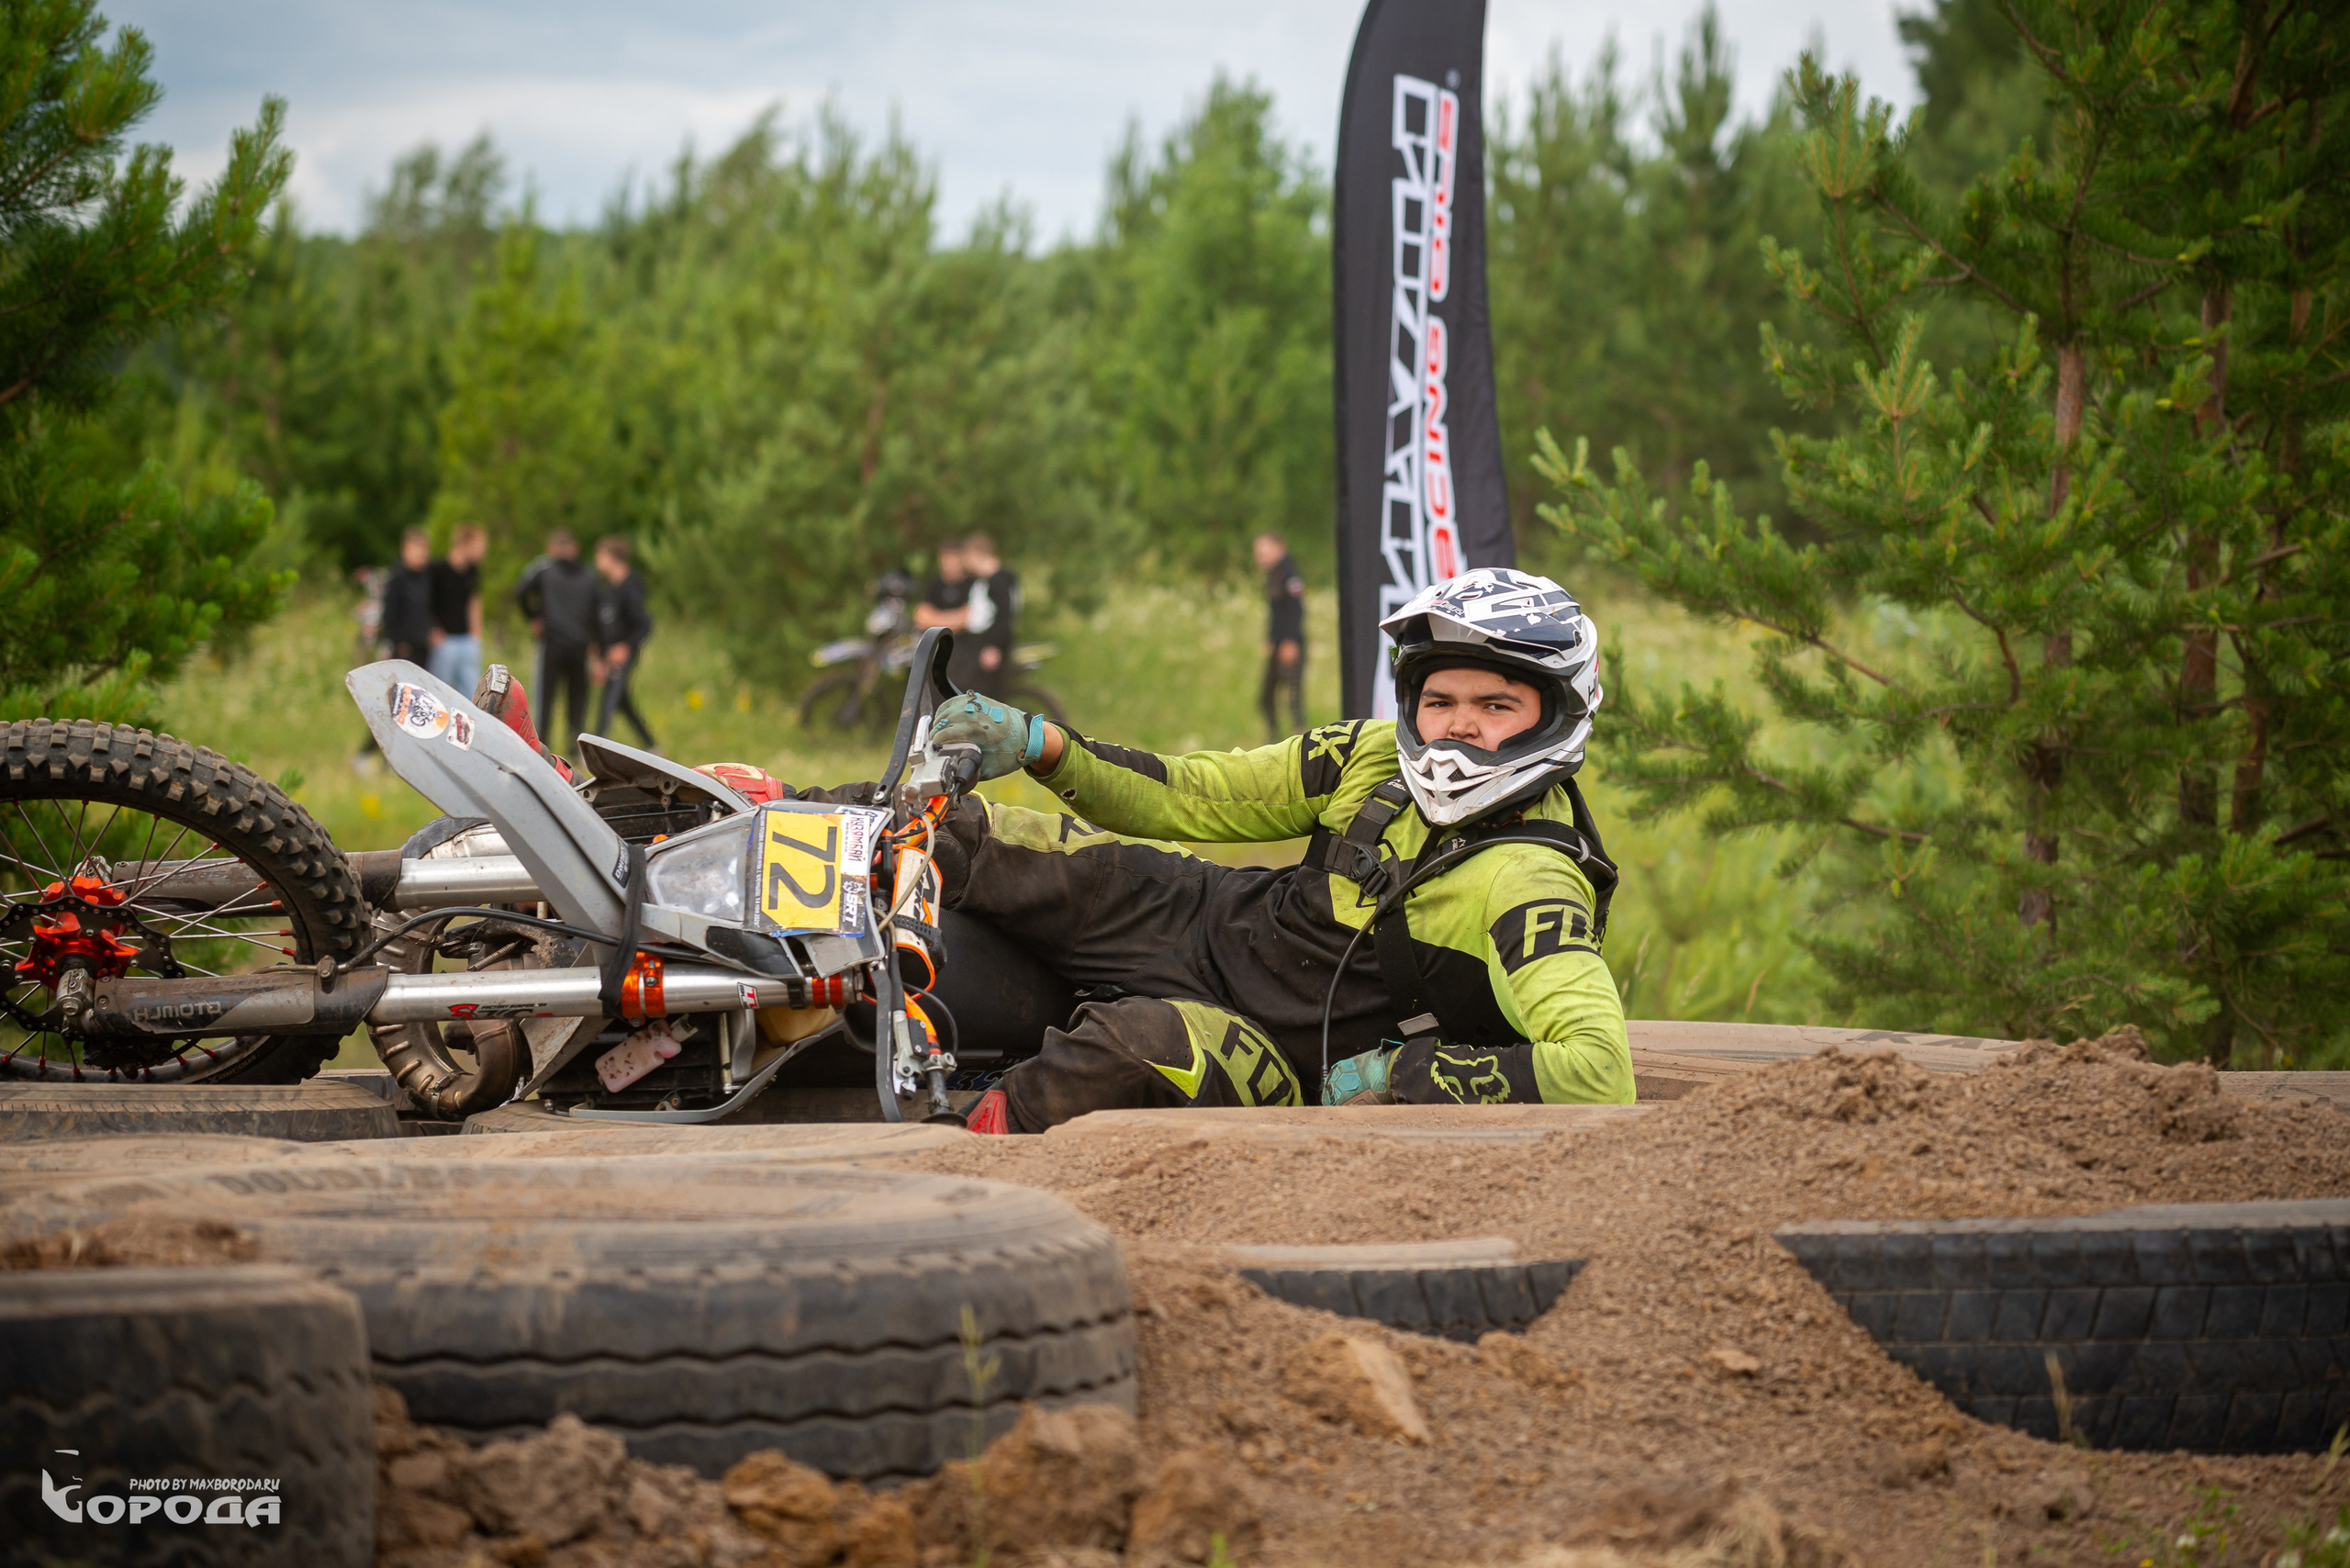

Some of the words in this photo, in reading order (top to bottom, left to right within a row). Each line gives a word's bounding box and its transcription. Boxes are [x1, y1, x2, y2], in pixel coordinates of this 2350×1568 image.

[1425, 319, 1461, 584] ACING
[768, 825, 837, 911] 72
[845, 893, 859, 927] SRT
[132, 1001, 221, 1022] HJMOTO
[1220, 1020, 1294, 1106] FO
